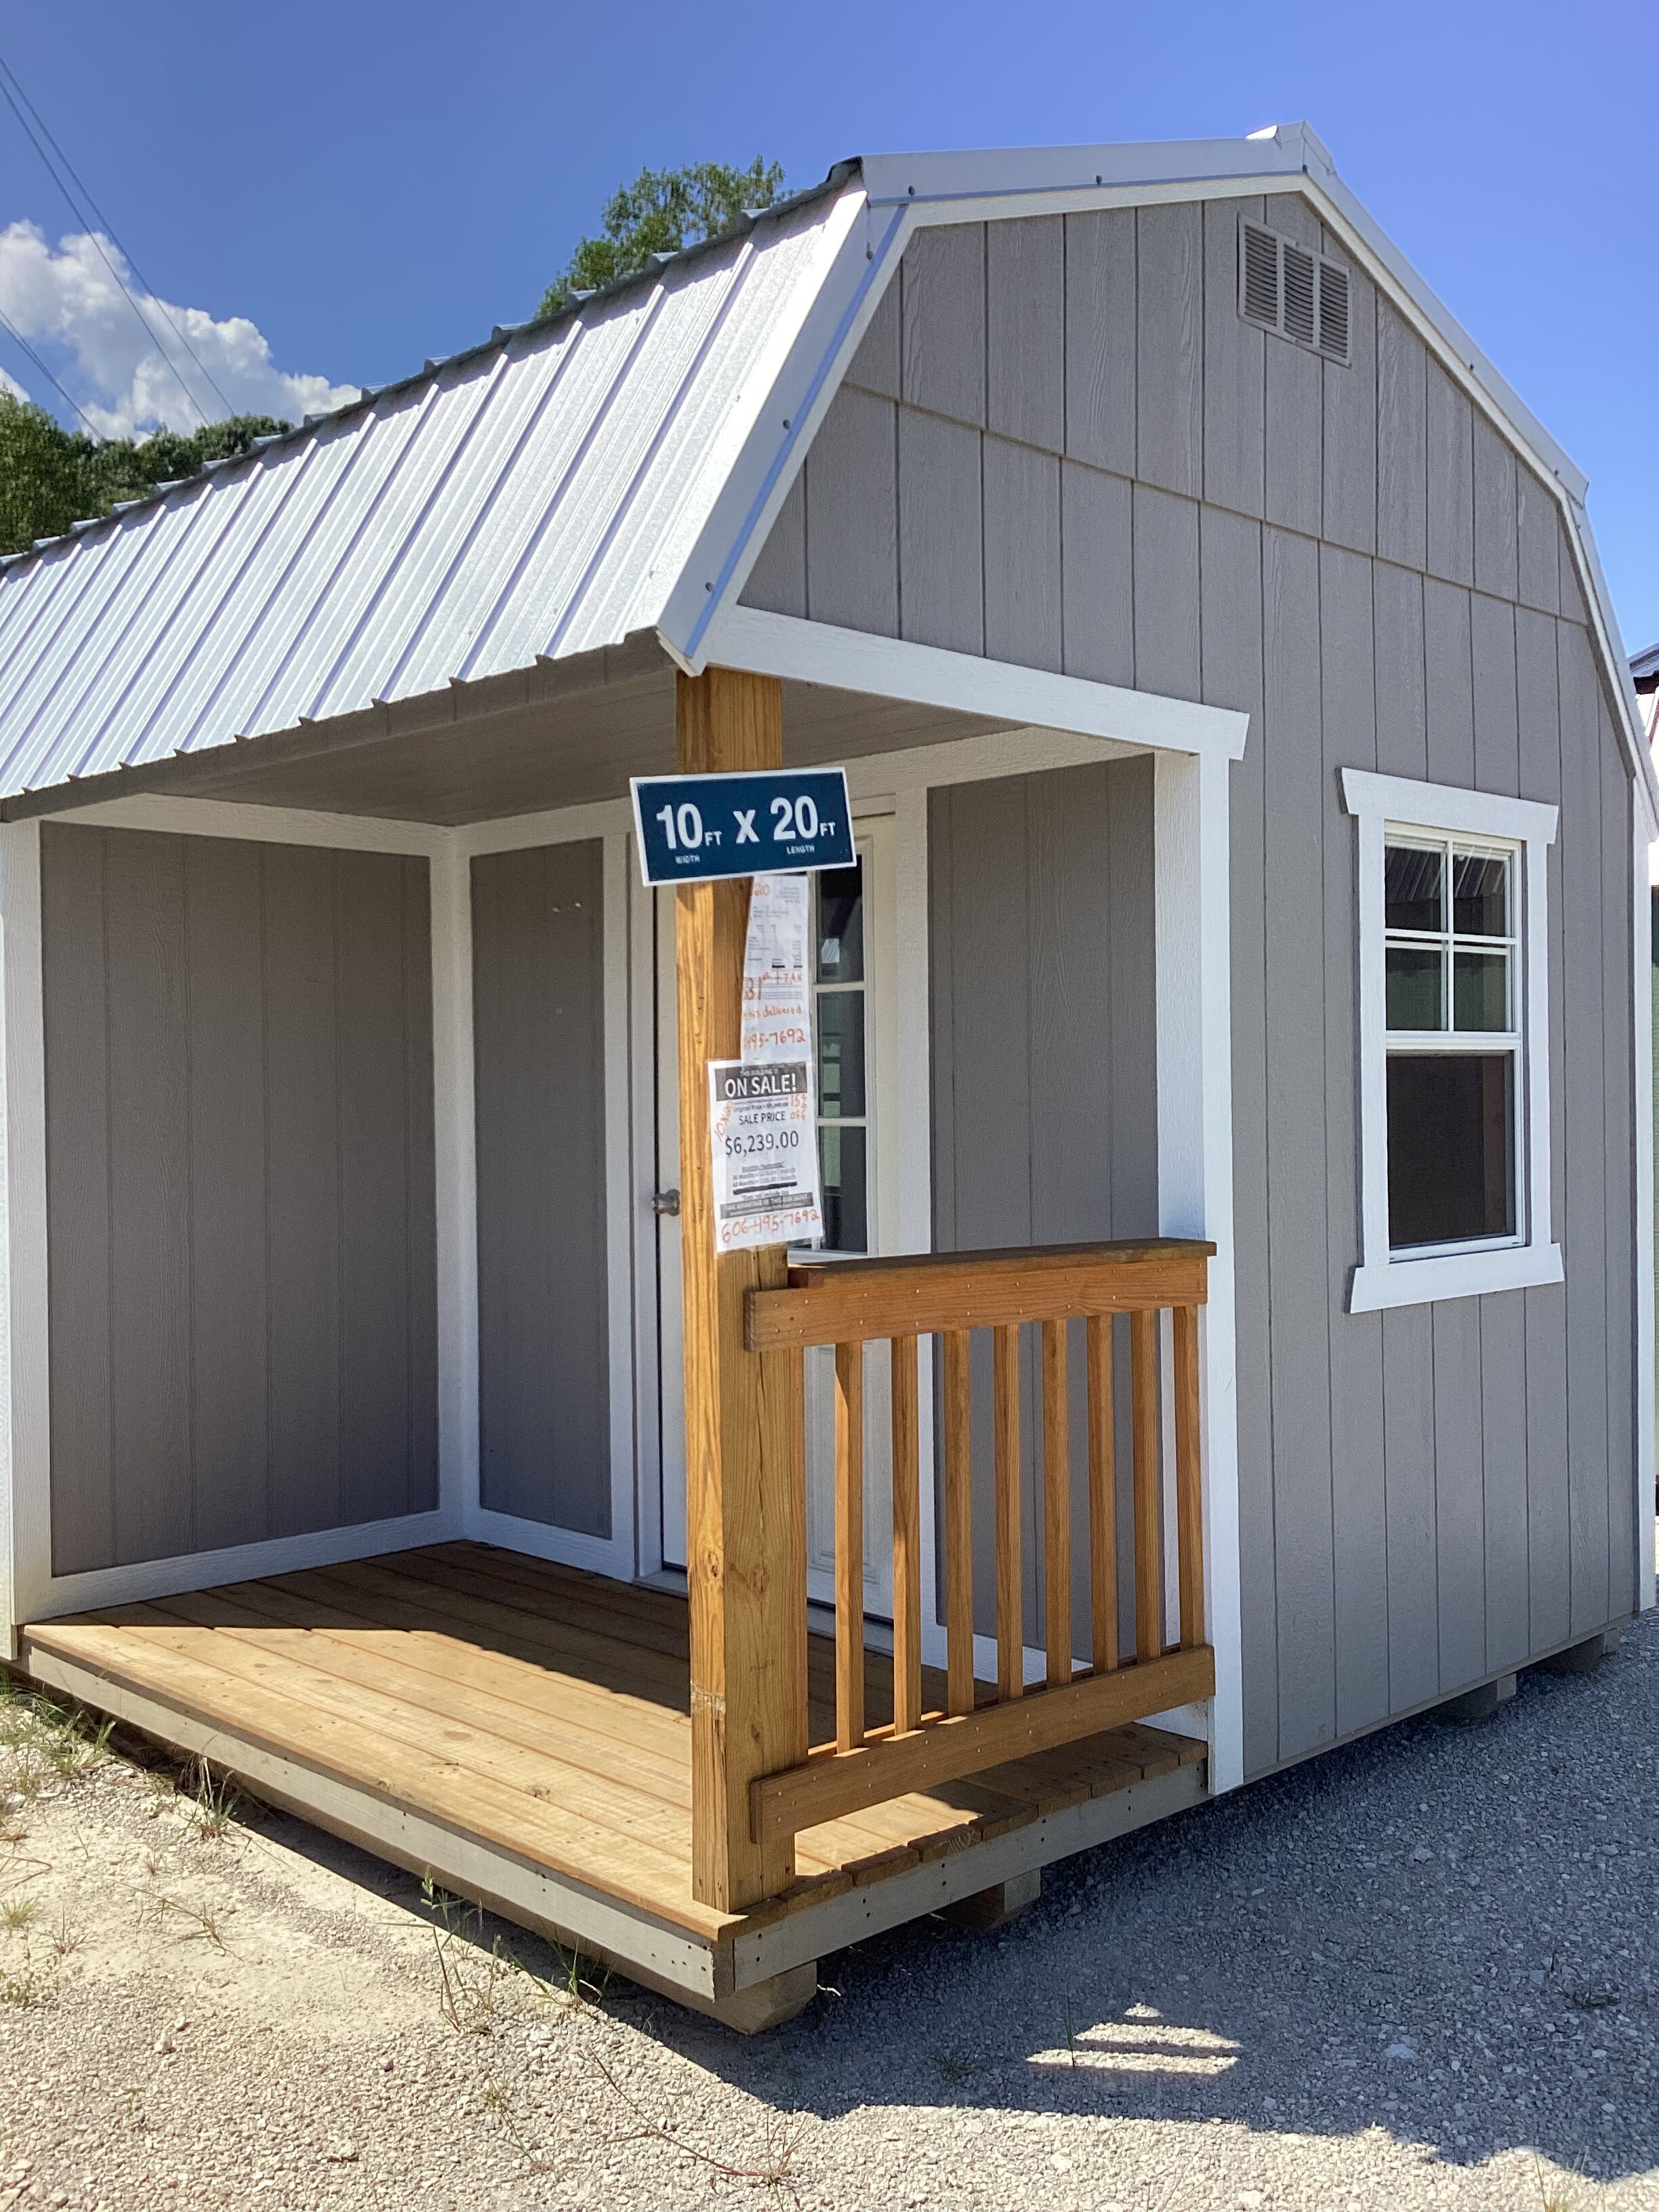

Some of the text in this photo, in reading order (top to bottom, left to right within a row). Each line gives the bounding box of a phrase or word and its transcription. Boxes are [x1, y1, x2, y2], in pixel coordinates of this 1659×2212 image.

[656, 802, 703, 850] 10
[770, 795, 818, 841] 20
[674, 855, 700, 864] WIDTH
[785, 844, 815, 855] LENGTH
[724, 1073, 796, 1098] ON SALE!
[739, 1111, 786, 1126] SALE PRICE
[725, 1130, 799, 1158] $6,239.00
